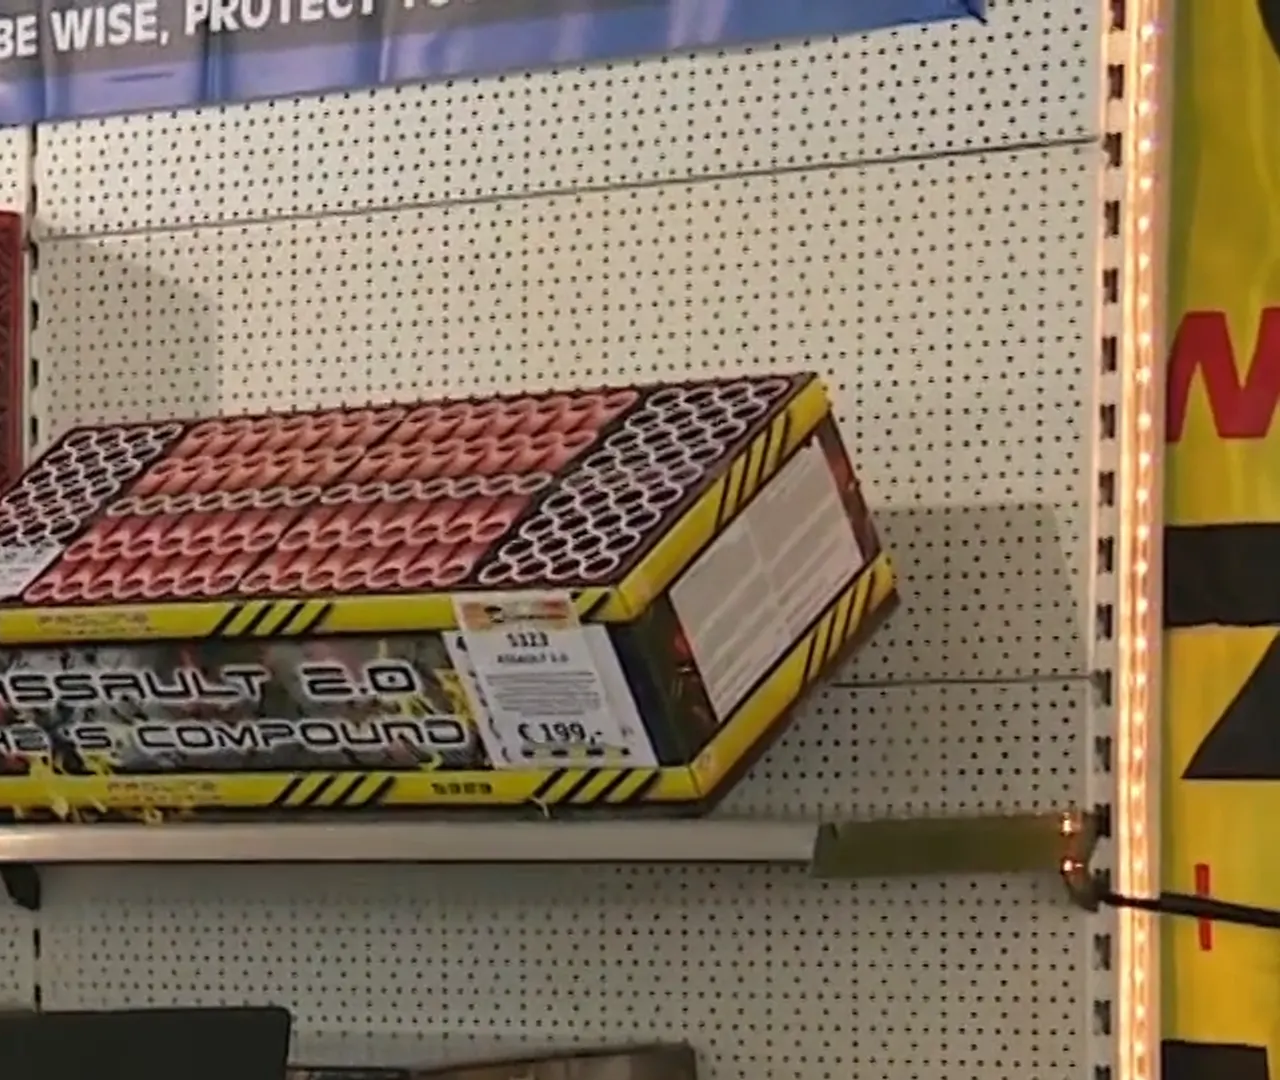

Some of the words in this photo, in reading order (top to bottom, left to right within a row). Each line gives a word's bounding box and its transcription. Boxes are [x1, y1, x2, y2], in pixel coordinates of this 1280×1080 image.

[51, 3, 170, 51] WISE,
[299, 659, 420, 700] 2.0
[133, 716, 468, 753] COMPOUND
